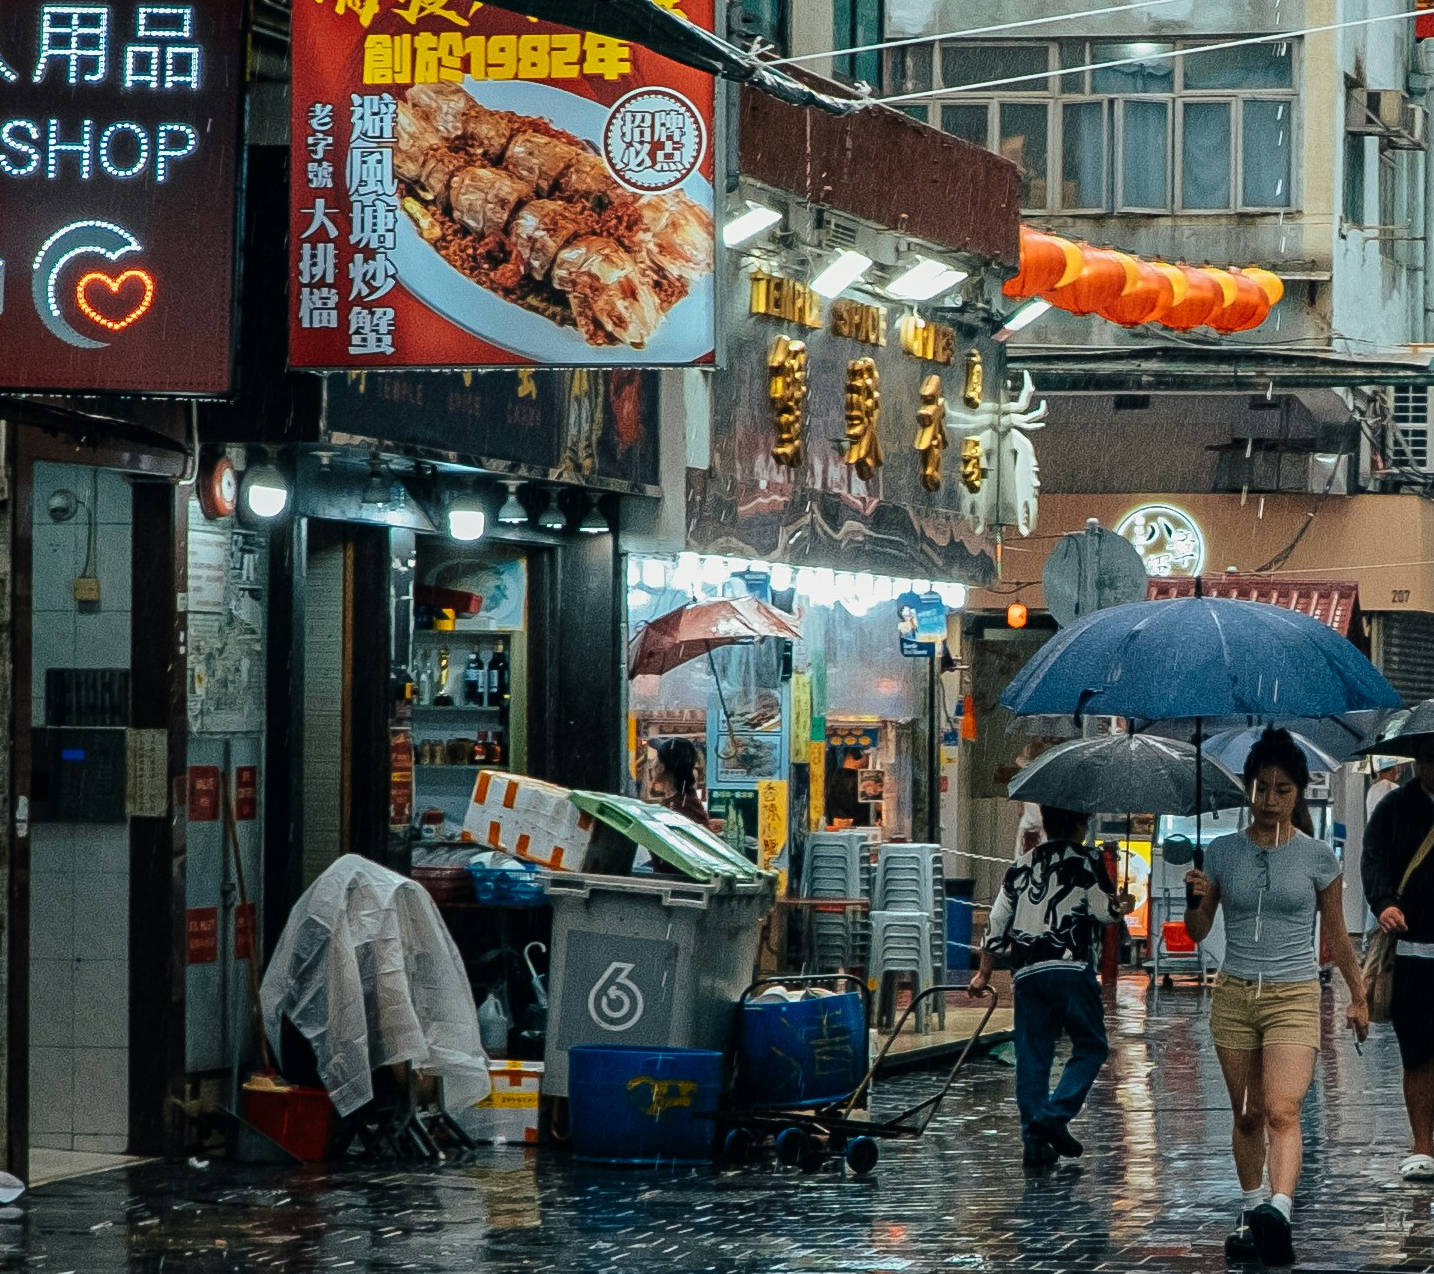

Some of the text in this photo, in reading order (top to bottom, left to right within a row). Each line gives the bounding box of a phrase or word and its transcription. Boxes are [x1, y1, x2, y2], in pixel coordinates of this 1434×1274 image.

[363, 31, 632, 85] 創於1982年
[620, 110, 686, 143] 招牌
[620, 141, 687, 173] 必点
[348, 92, 398, 357] 避風塘炒蟹
